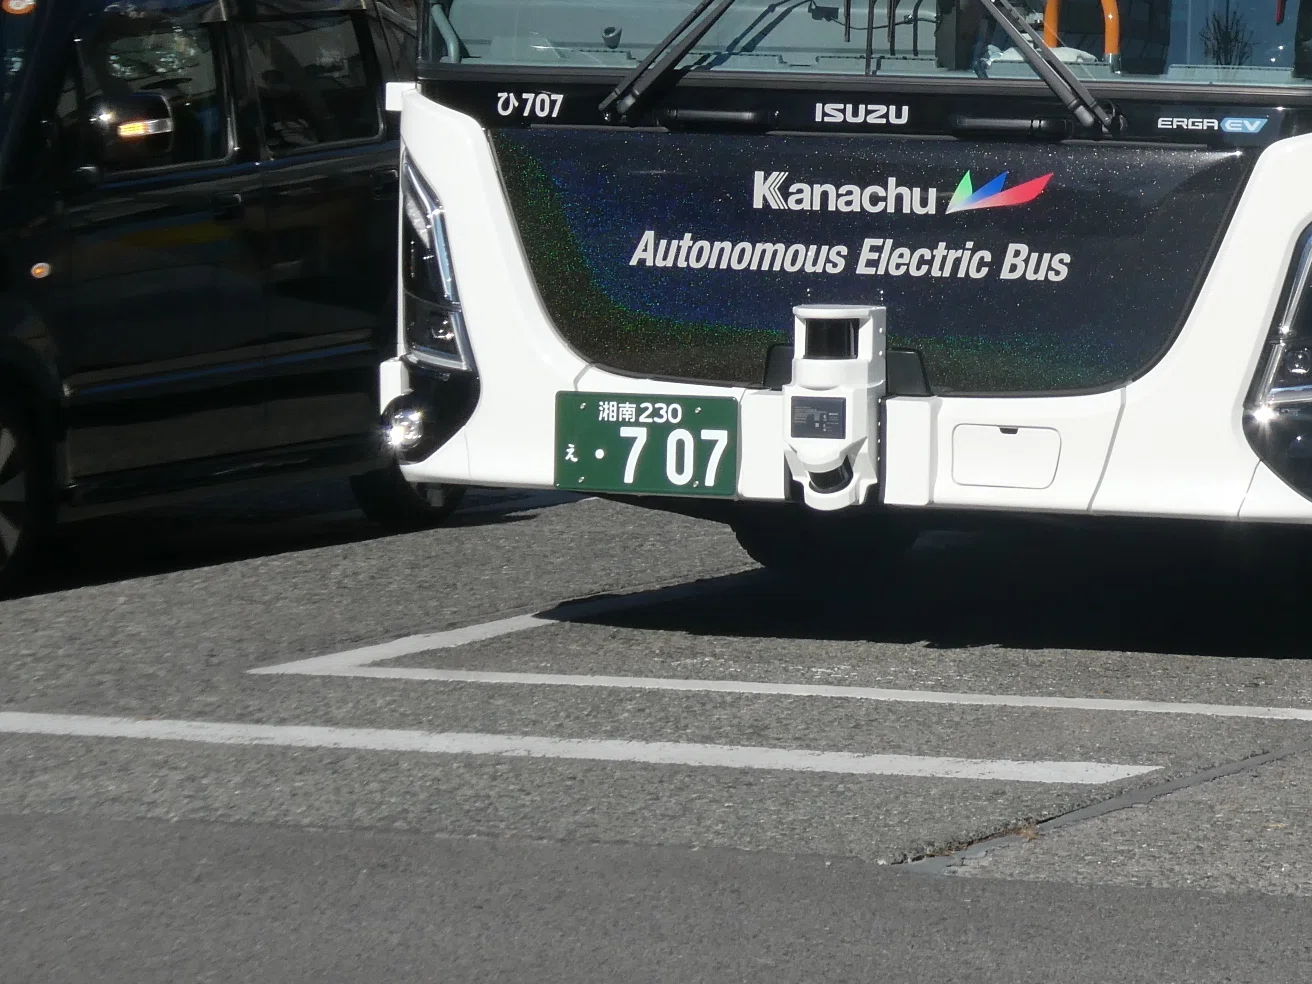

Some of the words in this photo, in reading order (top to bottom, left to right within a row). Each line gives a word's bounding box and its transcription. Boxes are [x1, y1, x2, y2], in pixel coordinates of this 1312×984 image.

[814, 103, 910, 125] ISUZU
[1157, 117, 1218, 130] ERGA
[1224, 119, 1261, 132] EV
[752, 170, 937, 215] Kanachu
[628, 230, 846, 274] Autonomous
[853, 237, 993, 279] Electric
[999, 243, 1072, 283] Bus
[565, 443, 579, 462] え
